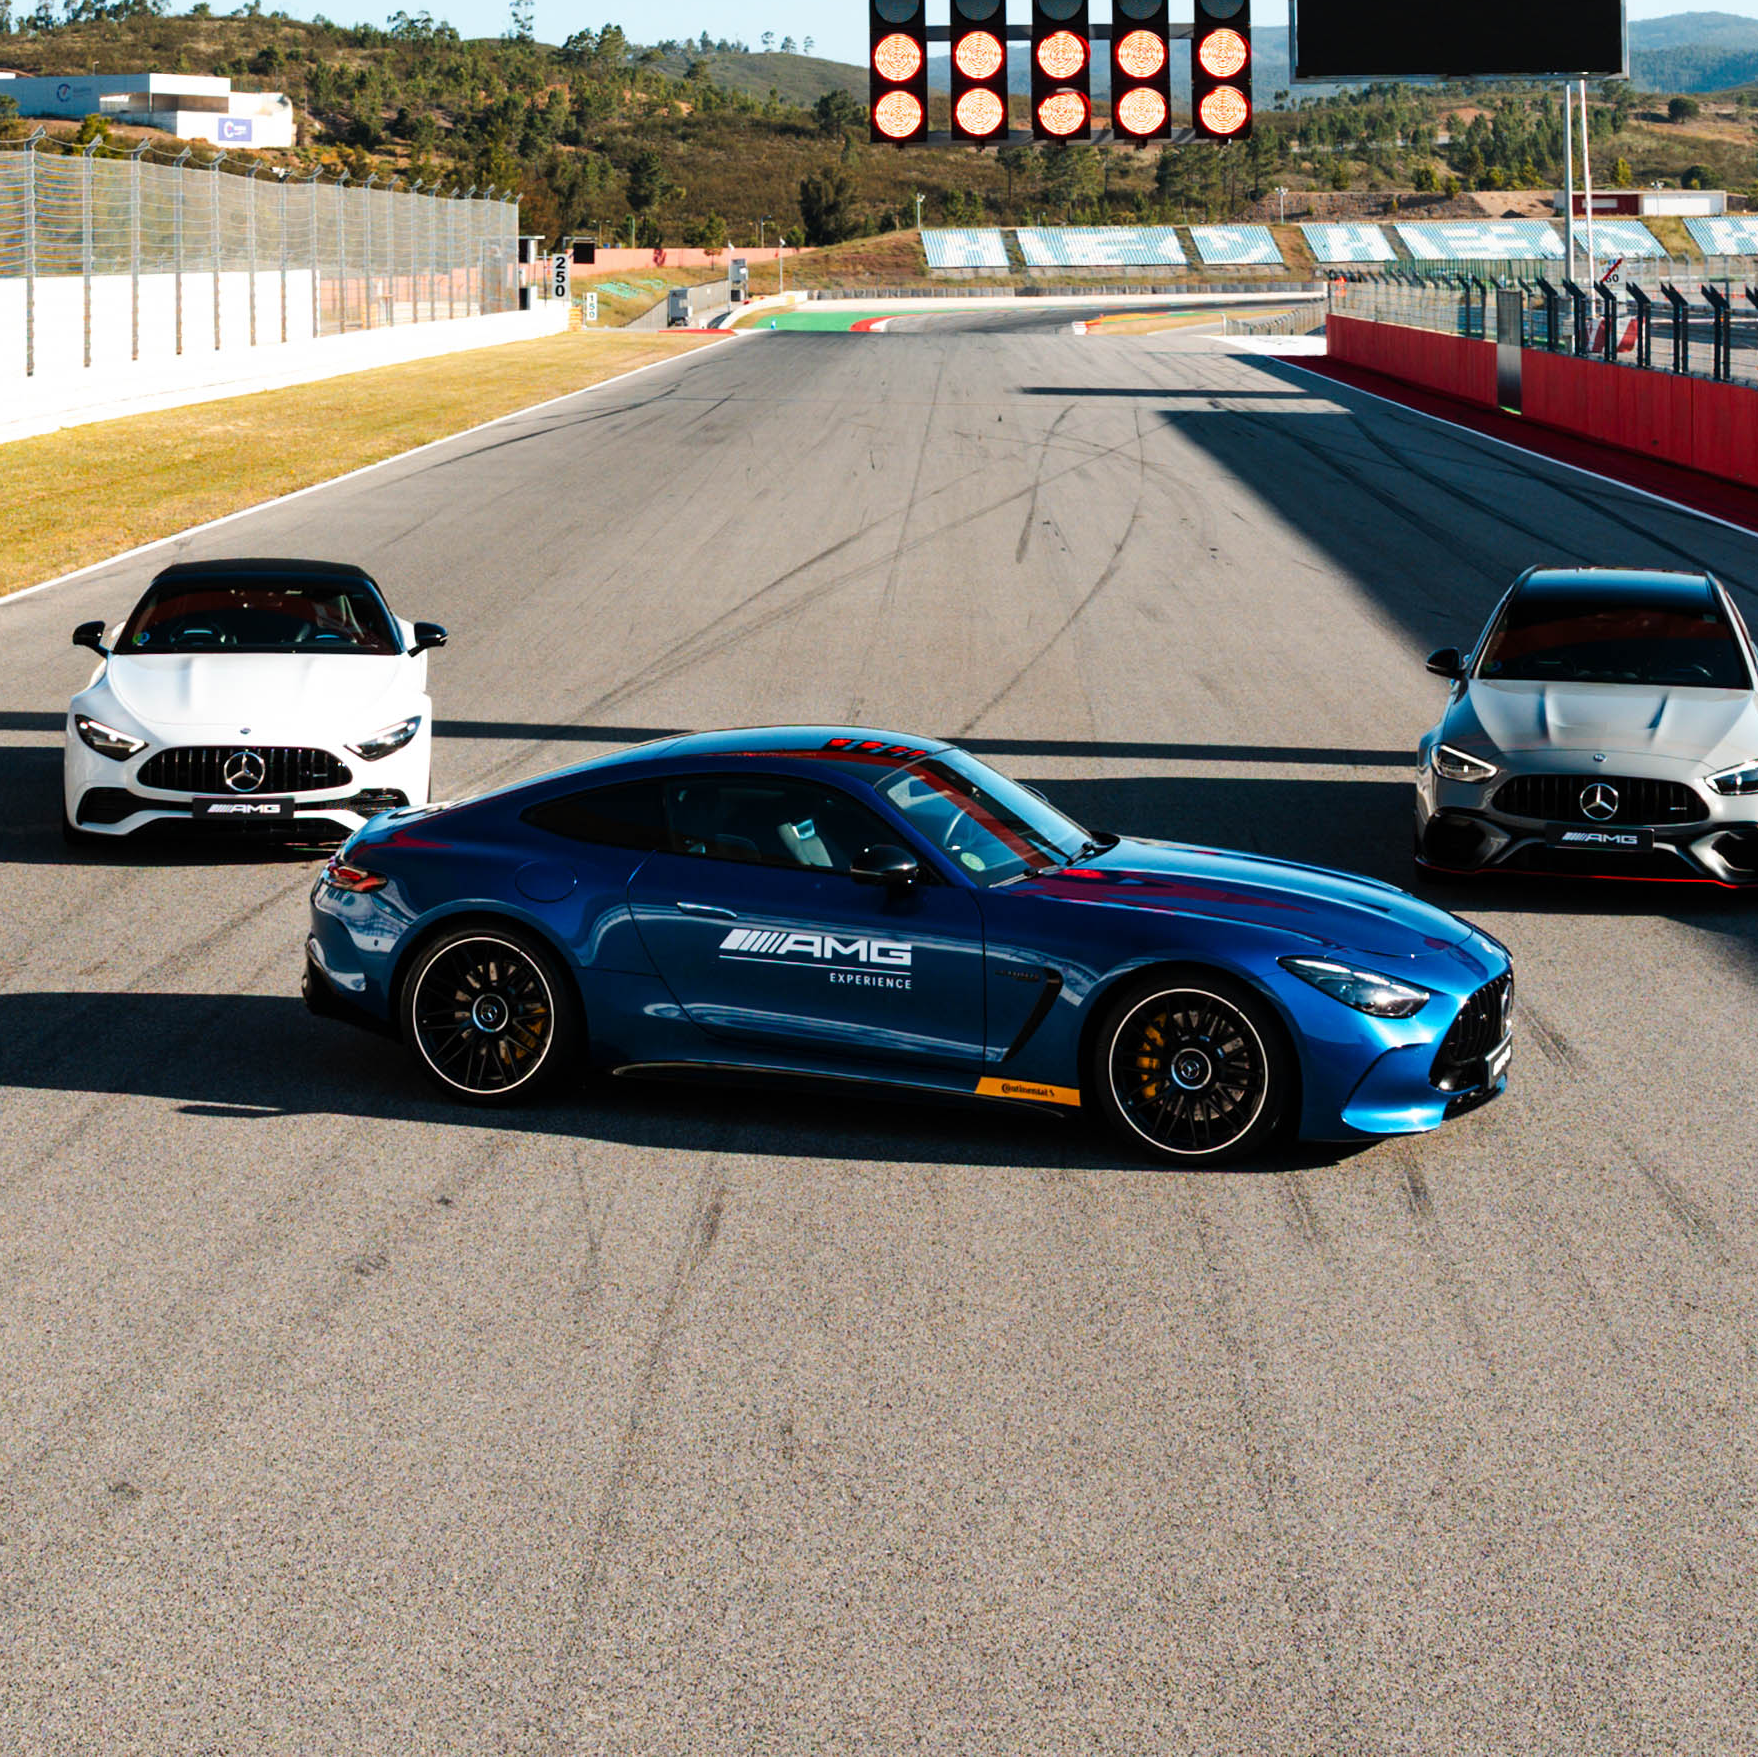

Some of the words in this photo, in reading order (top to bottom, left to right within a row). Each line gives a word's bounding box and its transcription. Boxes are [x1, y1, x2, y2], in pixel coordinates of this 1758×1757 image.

[554, 256, 566, 298] 250
[230, 803, 281, 814] AMG
[1584, 832, 1638, 845] AMG
[776, 933, 912, 966] AMG
[829, 972, 912, 990] EXPERIENCE
